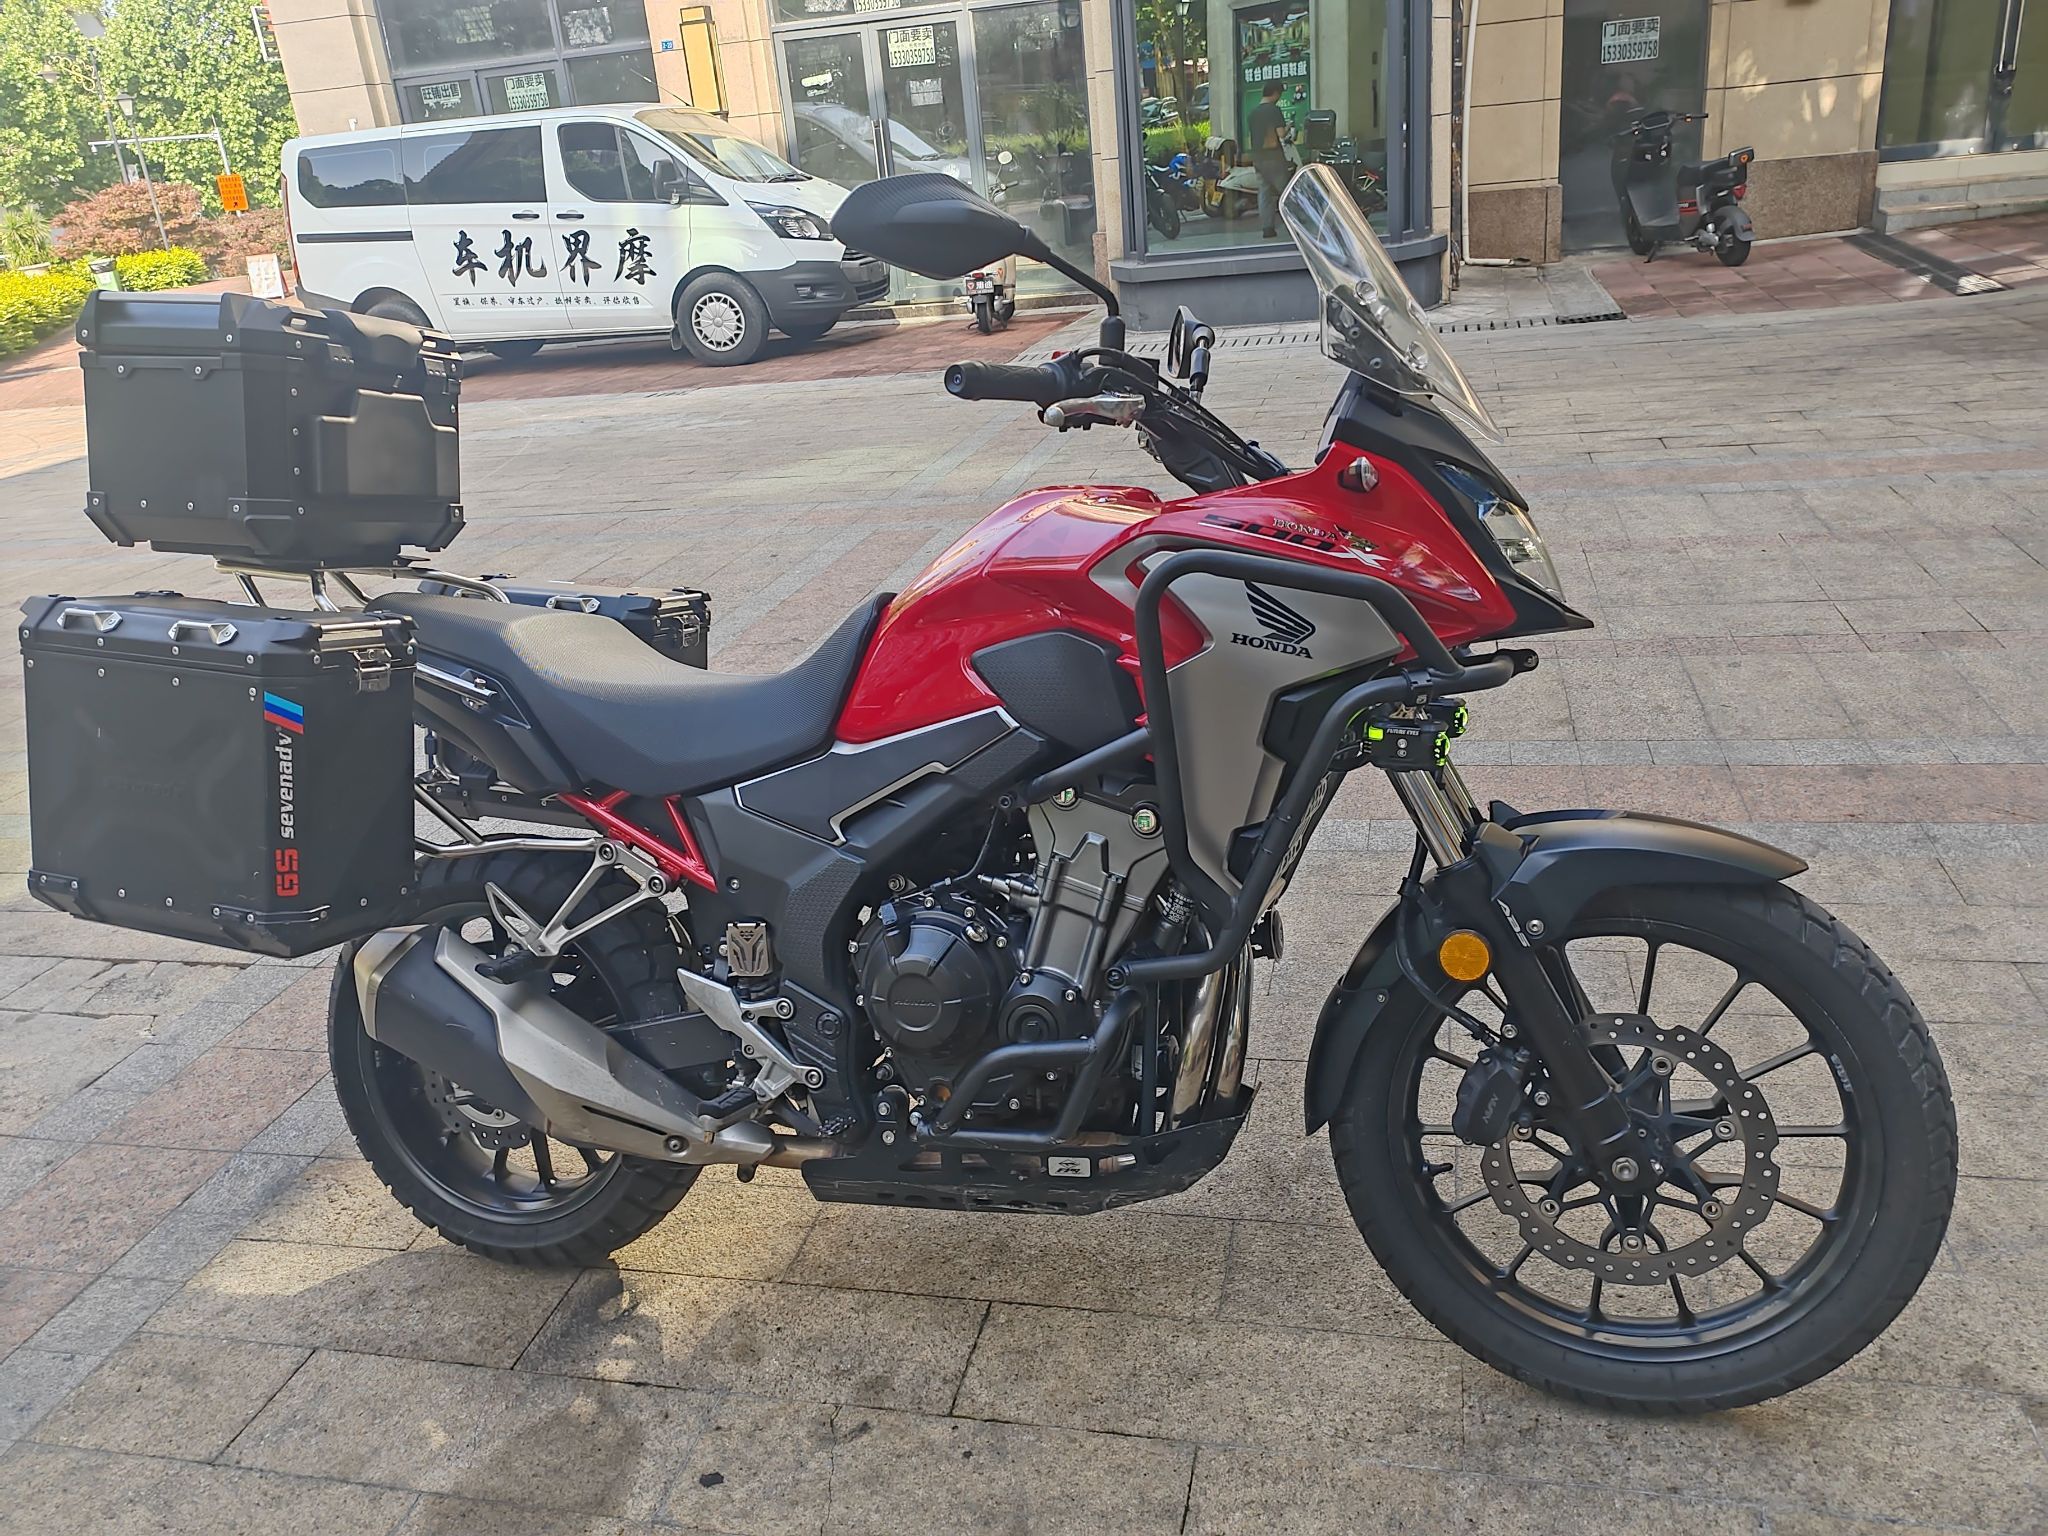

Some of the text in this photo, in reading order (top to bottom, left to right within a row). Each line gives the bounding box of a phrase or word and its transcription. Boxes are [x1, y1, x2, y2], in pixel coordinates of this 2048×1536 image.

[888, 27, 933, 44] 门面要卖
[1603, 18, 1659, 38] 门面要卖
[890, 47, 935, 66] 15330359758
[1602, 40, 1658, 62] 15330359758
[422, 83, 460, 100] 旺铺出售
[505, 74, 545, 90] 门面要卖
[508, 92, 549, 110] 15330359758
[1273, 517, 1339, 541] HONDA
[1203, 514, 1392, 570] 500X
[1230, 632, 1313, 659] HONDA
[275, 732, 299, 897] GS sevenadv
[1496, 899, 1531, 947] ABS
